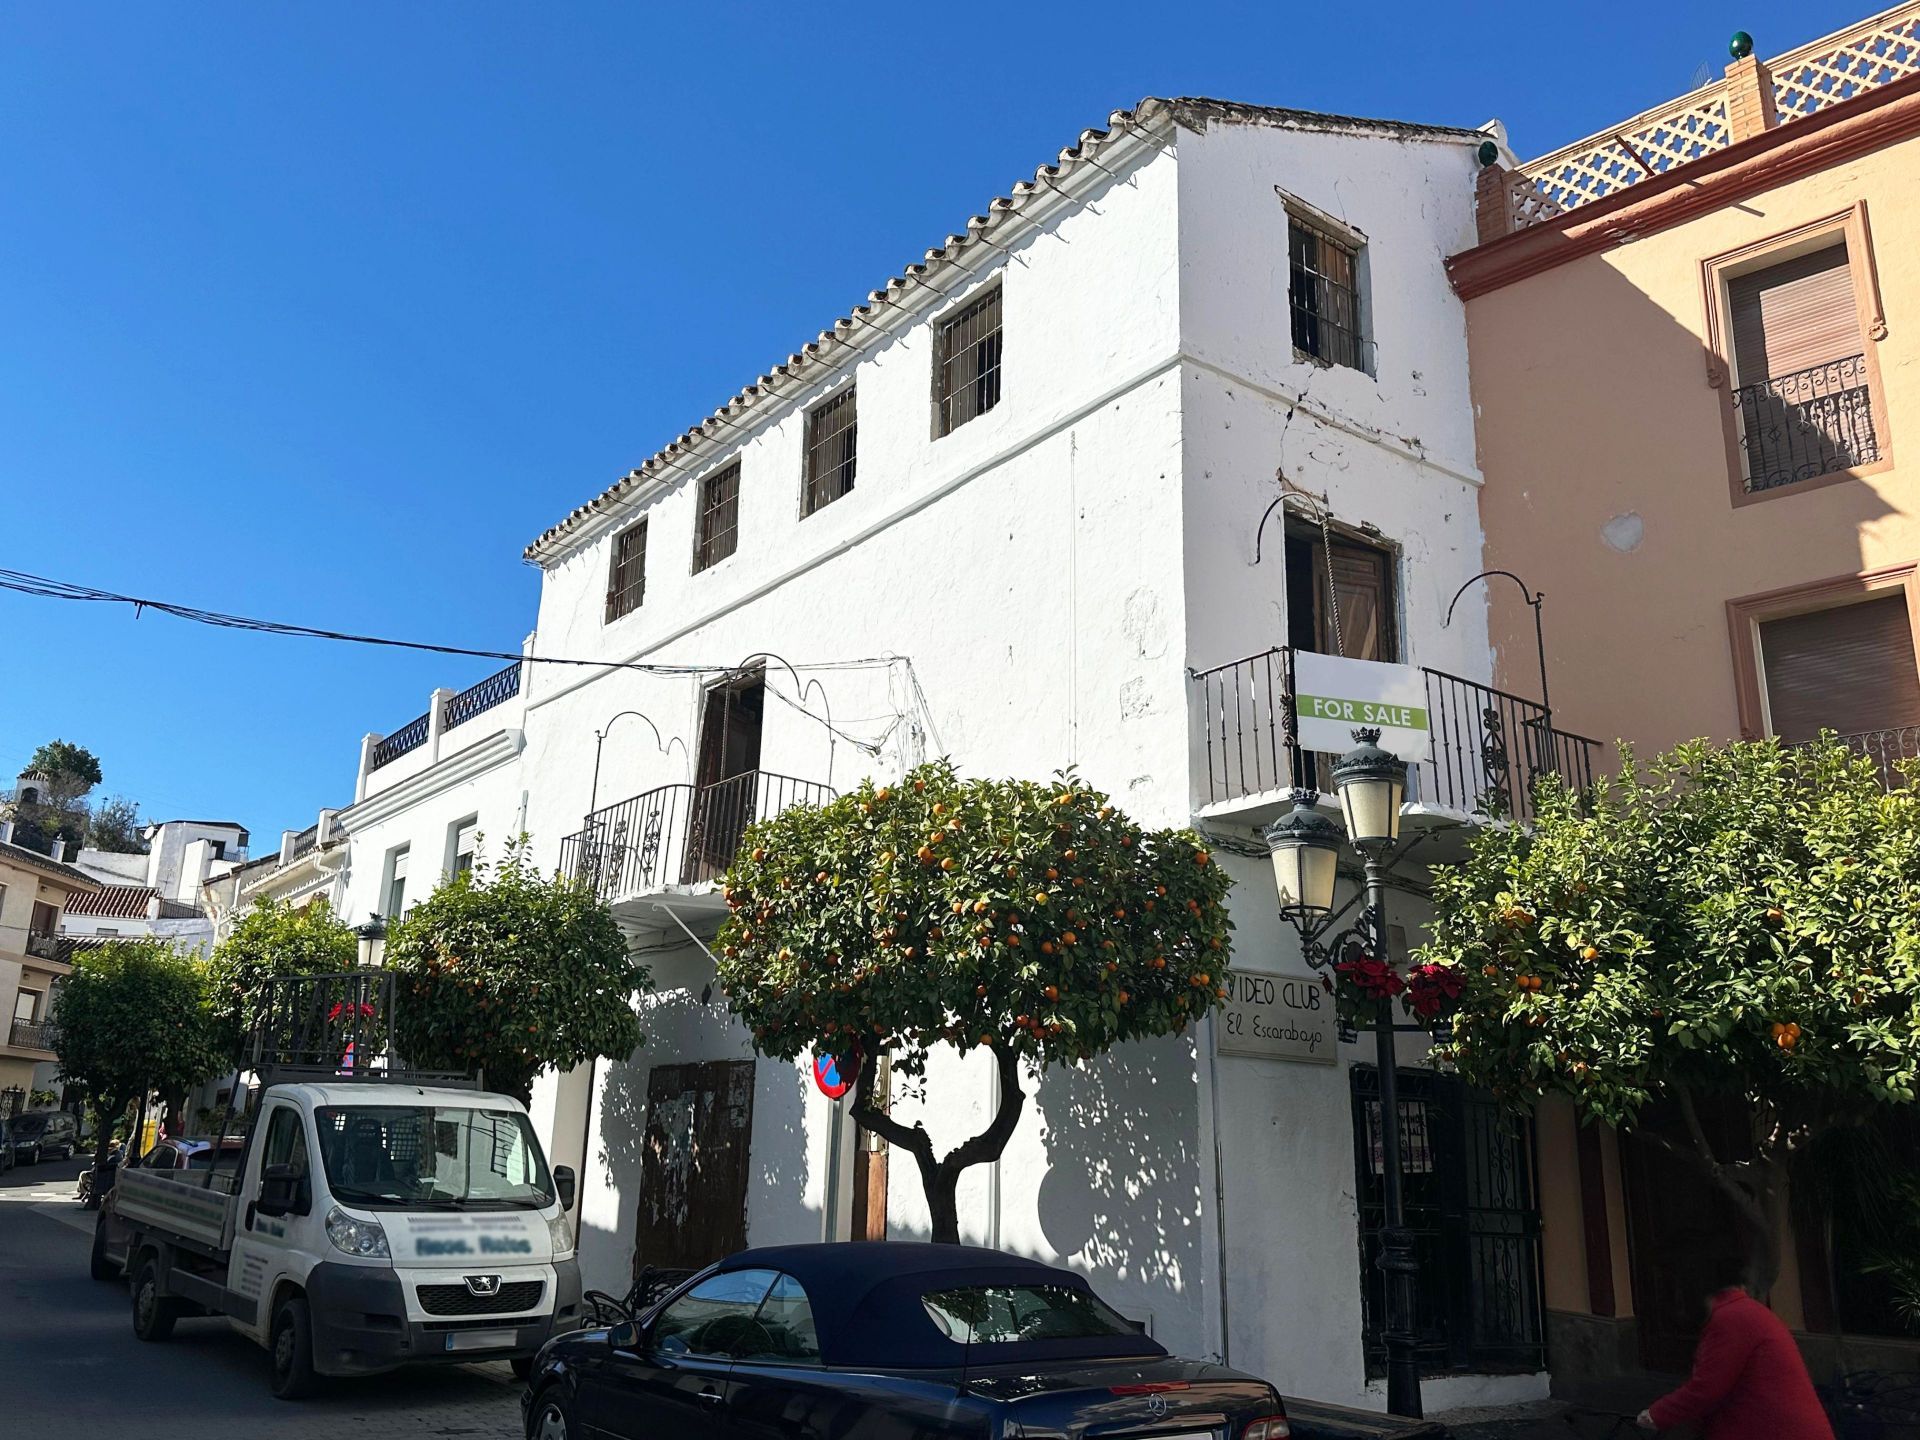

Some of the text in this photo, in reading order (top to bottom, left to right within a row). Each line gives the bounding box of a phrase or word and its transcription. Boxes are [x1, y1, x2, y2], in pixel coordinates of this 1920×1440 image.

[1314, 699, 1411, 726] FOR SALE
[1228, 976, 1320, 1011] VIDEO CLUB
[1227, 1012, 1322, 1053] El Escarabajo
